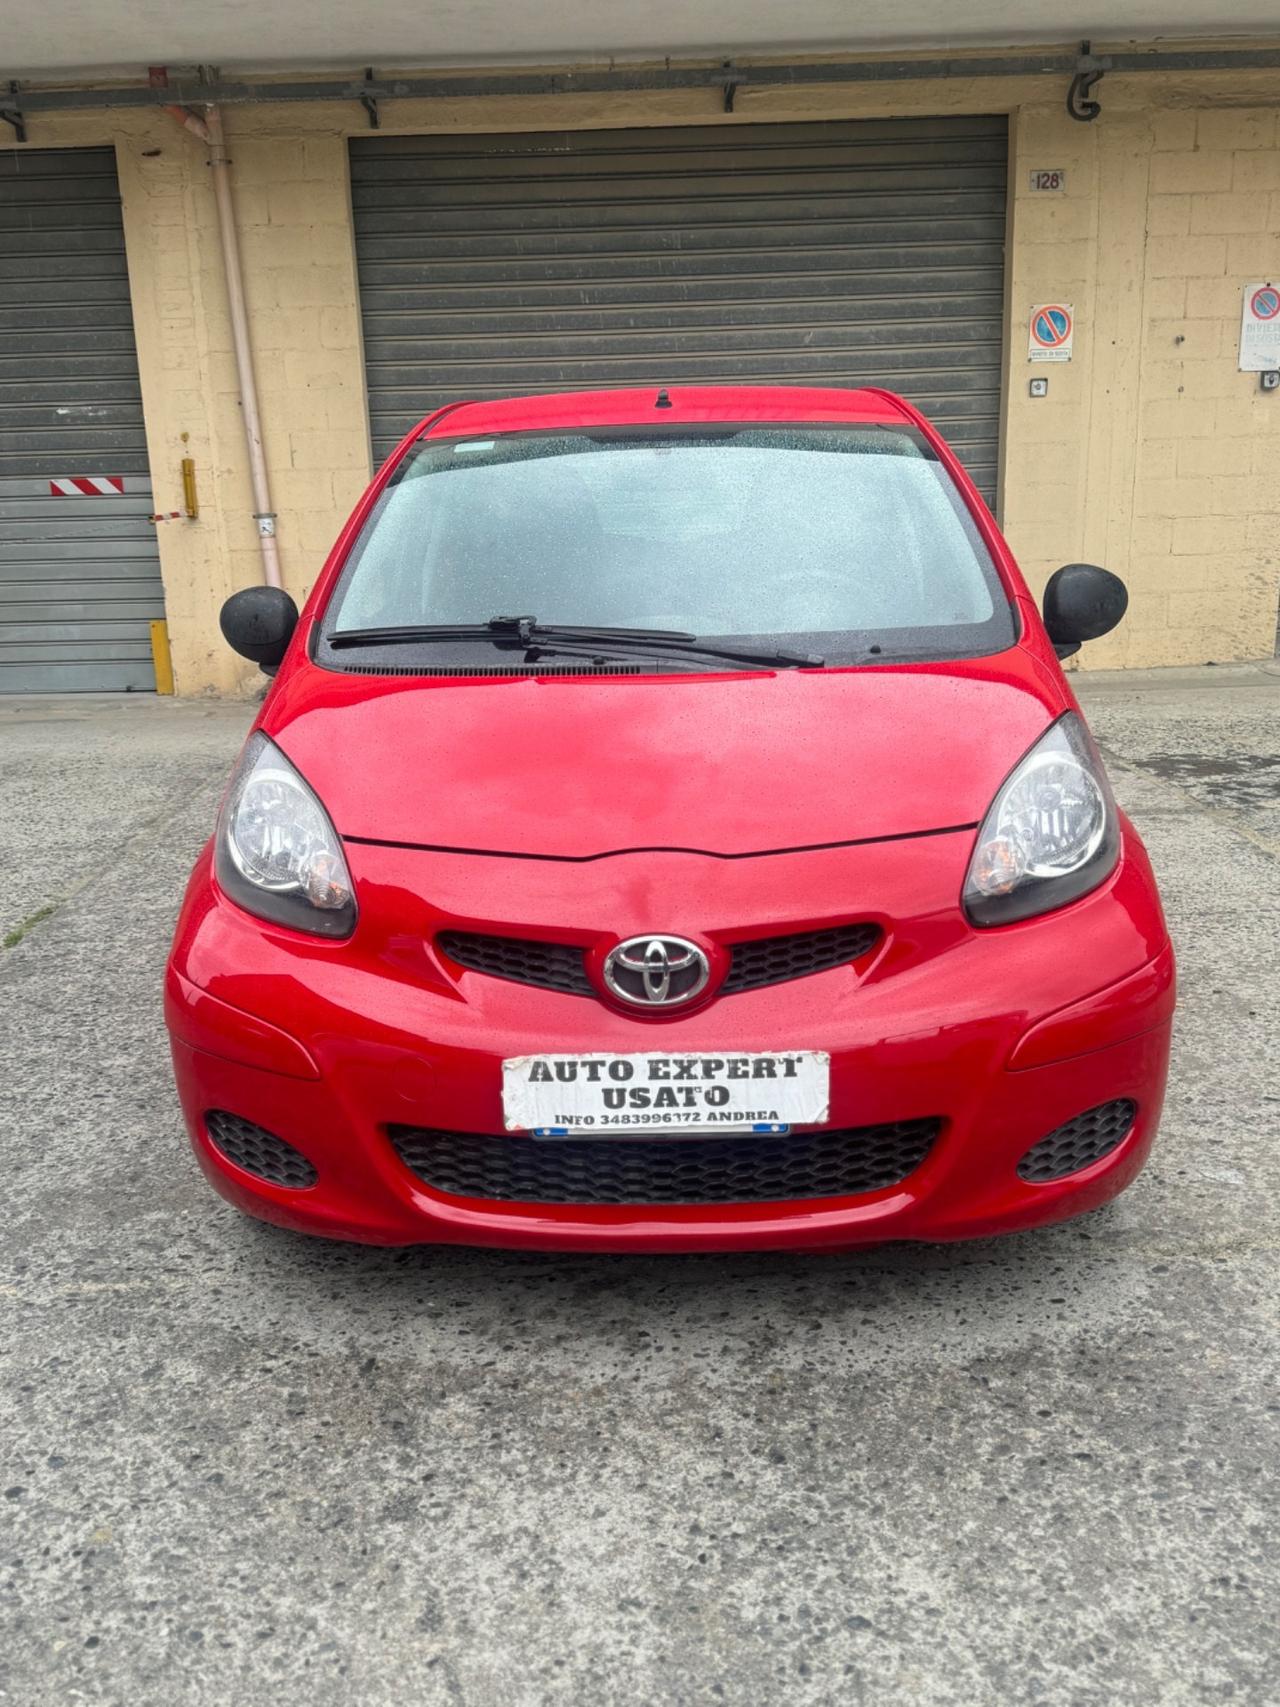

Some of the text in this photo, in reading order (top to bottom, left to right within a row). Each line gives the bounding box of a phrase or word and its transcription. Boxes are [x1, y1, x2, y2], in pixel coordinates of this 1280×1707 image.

[1036, 172, 1060, 190] 128
[528, 1058, 802, 1082] AUTO EXPERT
[601, 1085, 730, 1109] USATO
[554, 1114, 595, 1126] INFO
[706, 1110, 779, 1121] ANDREA
